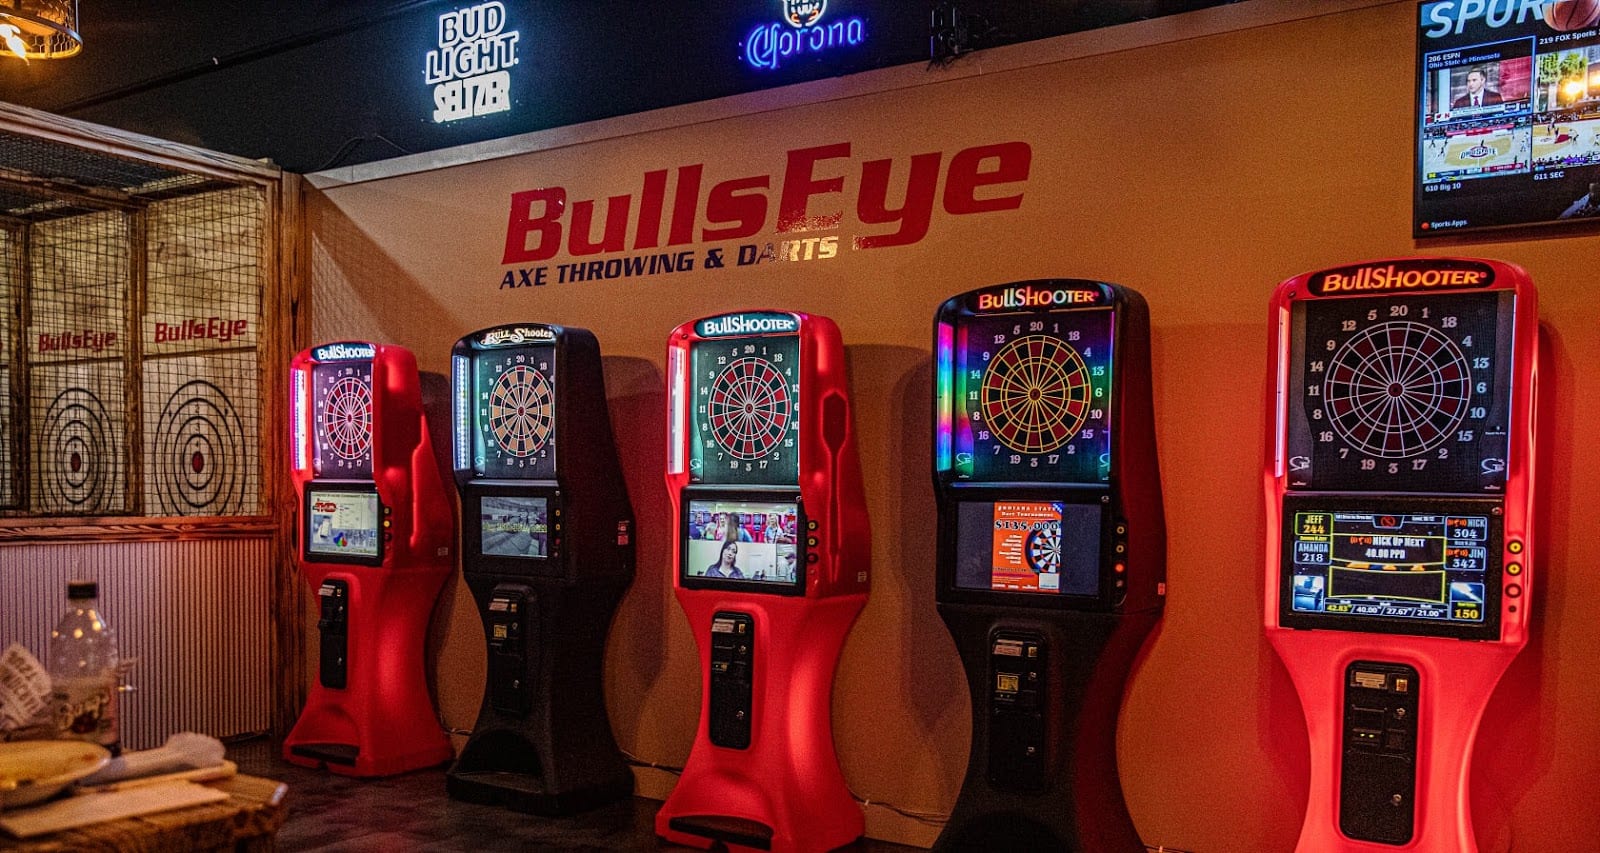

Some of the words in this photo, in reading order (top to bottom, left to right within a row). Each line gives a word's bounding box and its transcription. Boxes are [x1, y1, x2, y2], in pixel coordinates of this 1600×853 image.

[438, 1, 506, 49] BUD
[1555, 33, 1571, 42] FOX
[1572, 30, 1597, 40] Sports
[747, 18, 861, 69] Corona
[1443, 51, 1461, 61] ESPN
[433, 70, 511, 123] SELTZER
[1533, 173, 1547, 181] 611
[1550, 171, 1565, 179] SEC
[1425, 184, 1439, 192] 610
[1440, 183, 1451, 192] Big
[1452, 182, 1462, 190] 10
[501, 141, 1032, 265] BullsEye
[1431, 222, 1451, 230] Sports
[499, 266, 548, 289] AXE
[557, 251, 695, 284] THROWING
[704, 247, 725, 269] &
[737, 236, 839, 266] DARTS
[1367, 309, 1377, 320] 5
[1390, 306, 1408, 317] 20
[1422, 307, 1429, 318] 1
[1030, 322, 1043, 331] 20
[1054, 323, 1059, 332] 1
[1342, 320, 1356, 331] 12
[1442, 317, 1457, 328] 18
[154, 316, 247, 343] BullsEye
[1013, 325, 1020, 335] 5
[39, 329, 117, 352] BullsEye
[994, 334, 1005, 344] 12
[1068, 331, 1080, 340] 18
[1326, 339, 1336, 350] 9
[1462, 336, 1472, 347] 4
[732, 347, 738, 356] 5
[983, 352, 990, 361] 9
[1084, 347, 1091, 357] 4
[717, 356, 726, 364] 12
[774, 354, 783, 362] 18
[1473, 357, 1489, 369] 13
[1092, 366, 1104, 376] 13
[1310, 361, 1324, 372] 14
[709, 371, 715, 379] 9
[785, 368, 791, 376] 4
[970, 370, 981, 379] 14
[701, 387, 708, 395] 14
[1095, 388, 1102, 397] 6
[1308, 385, 1320, 396] 11
[1477, 382, 1487, 393] 6
[970, 391, 978, 400] 11
[700, 405, 706, 413] 11
[1313, 409, 1322, 419] 8
[1470, 407, 1485, 418] 10
[973, 412, 980, 421] 8
[1090, 410, 1102, 419] 10
[702, 423, 707, 431] 8
[979, 431, 989, 440] 16
[1082, 430, 1093, 439] 15
[1319, 432, 1333, 442] 16
[1457, 431, 1473, 442] 15
[784, 439, 793, 447] 15
[993, 445, 1000, 454] 7
[1068, 445, 1075, 454] 2
[1339, 448, 1349, 459] 7
[1438, 448, 1448, 459] 2
[774, 452, 779, 460] 2
[1010, 455, 1021, 464] 19
[1048, 455, 1059, 464] 17
[731, 460, 738, 469] 19
[759, 460, 768, 469] 17
[1031, 458, 1038, 467] 3
[1361, 460, 1375, 470] 19
[1412, 459, 1427, 470] 17
[1388, 463, 1398, 473] 3
[1304, 515, 1325, 525] JEFF
[1467, 519, 1485, 528] NICK
[1453, 528, 1478, 538] 304
[1298, 543, 1329, 553] AMANDA
[1302, 552, 1324, 562] 218
[1468, 549, 1484, 559] JIM
[1452, 558, 1477, 569] 342
[1455, 609, 1479, 619] 150
